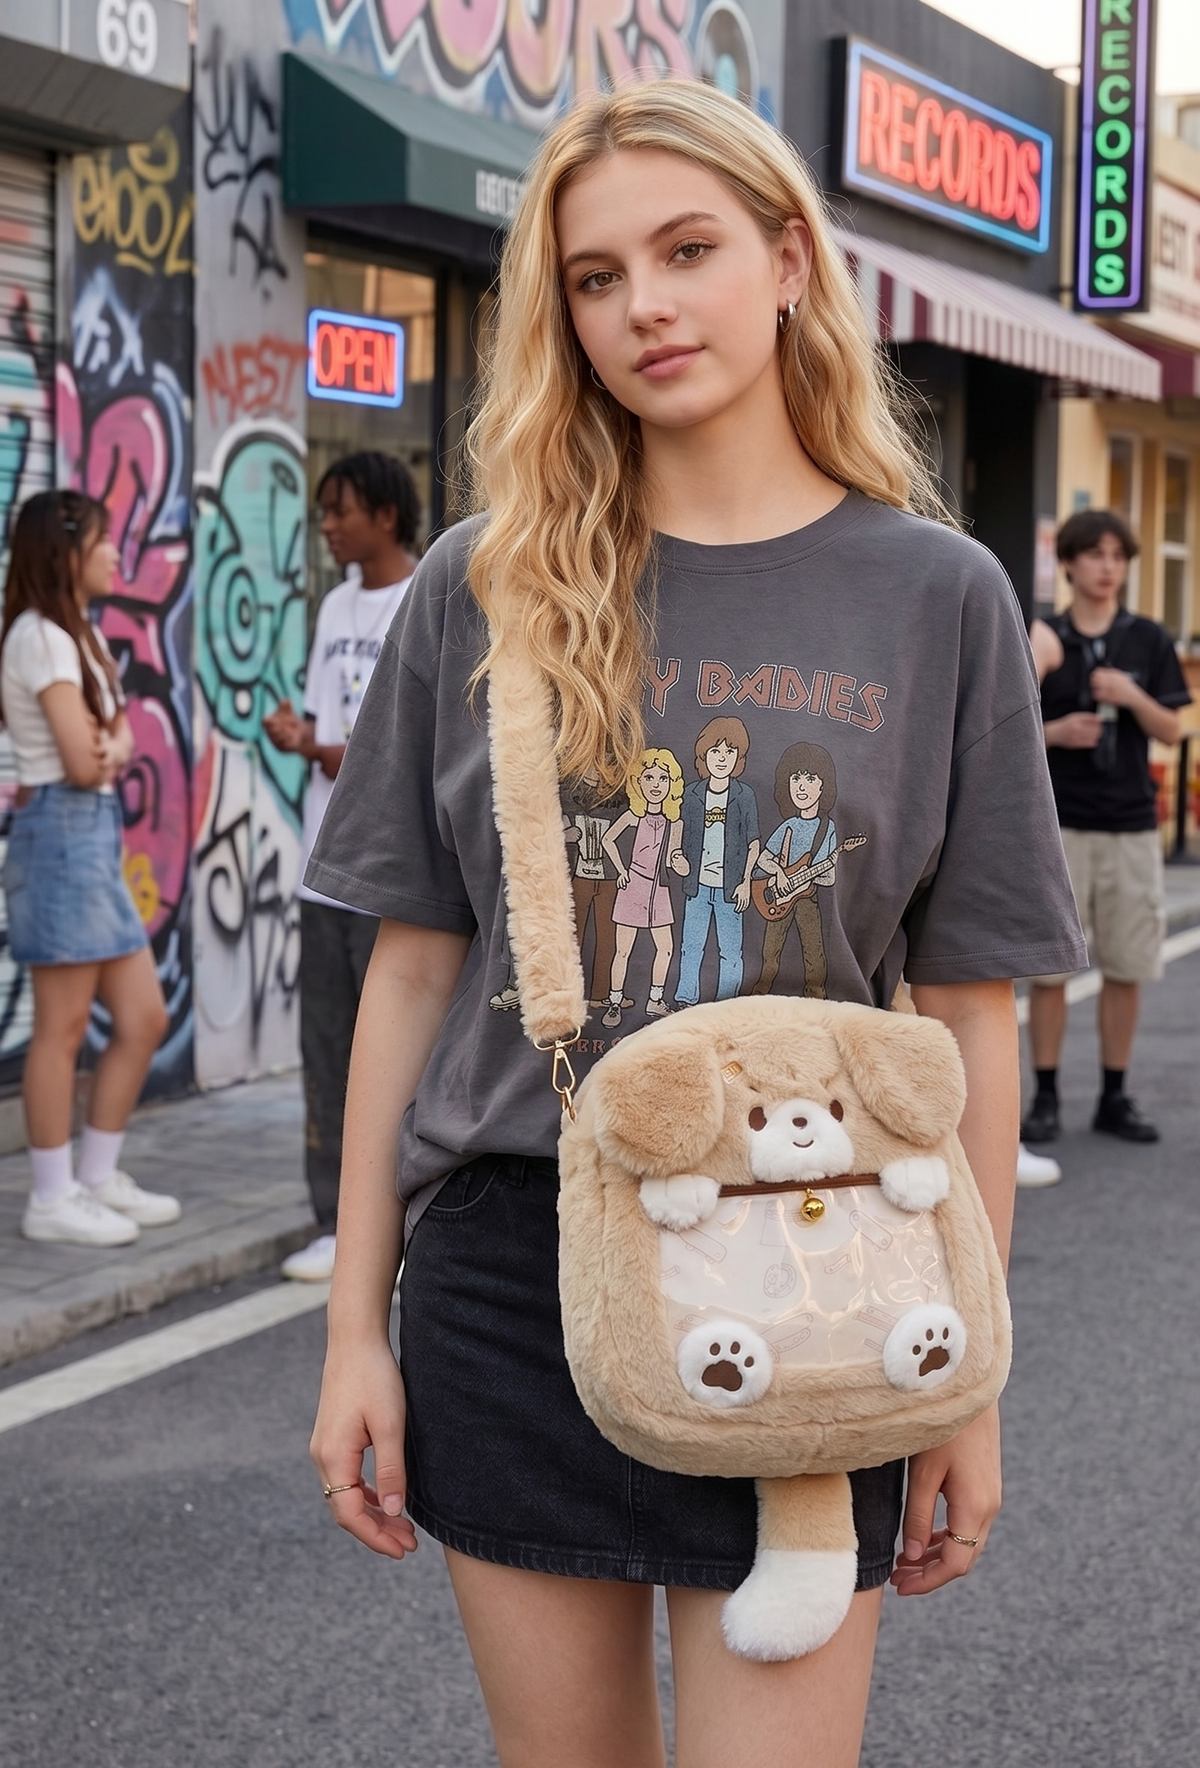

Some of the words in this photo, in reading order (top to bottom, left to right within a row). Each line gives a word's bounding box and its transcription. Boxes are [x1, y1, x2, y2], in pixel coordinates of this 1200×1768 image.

[97, 0, 157, 75] 69
[859, 69, 1041, 231] RECORDS
[1093, 0, 1132, 295] RECORDS
[314, 323, 397, 396] OPEN
[645, 656, 682, 717] Y
[697, 659, 888, 732] BADIES
